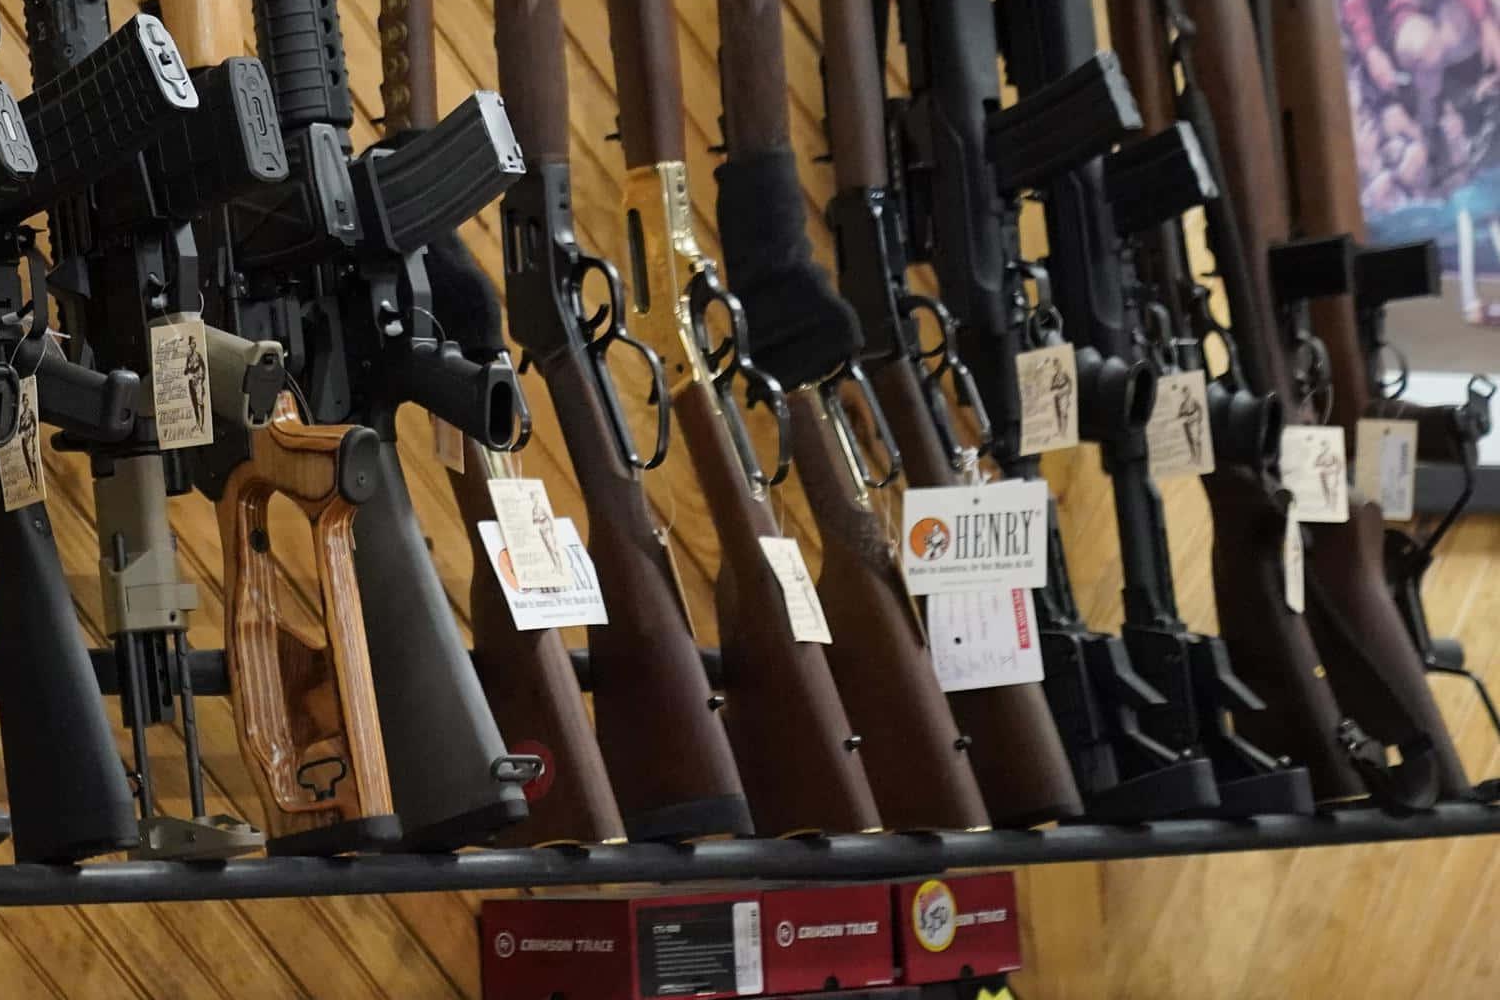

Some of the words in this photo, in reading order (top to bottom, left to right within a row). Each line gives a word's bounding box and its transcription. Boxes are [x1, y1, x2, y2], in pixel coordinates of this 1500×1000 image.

[955, 510, 1034, 560] HENRY
[797, 925, 845, 940] CRIMSON
[845, 921, 879, 936] TRACE
[520, 939, 573, 952] CRIMSON
[575, 939, 614, 952] TRACE
